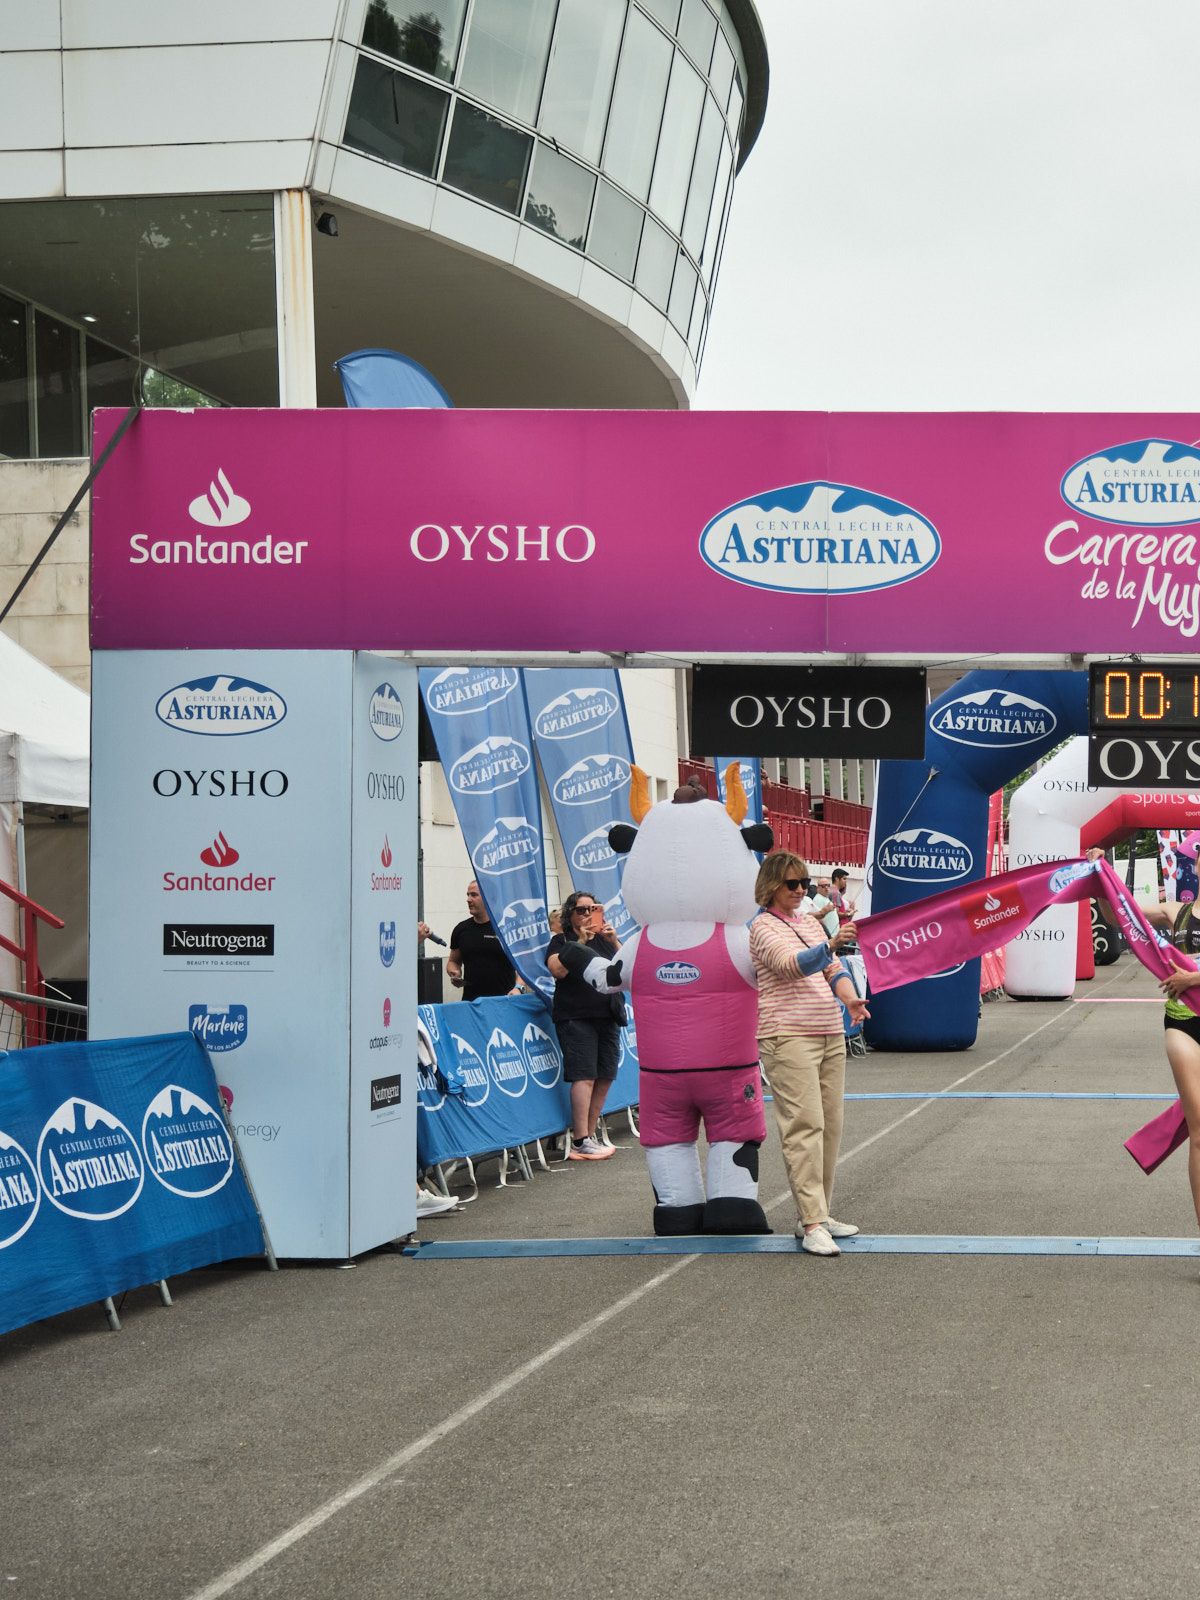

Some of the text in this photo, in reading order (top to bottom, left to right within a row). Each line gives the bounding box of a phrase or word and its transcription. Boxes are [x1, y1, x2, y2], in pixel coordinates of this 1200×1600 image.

[1103, 469, 1162, 479] CENTRAL
[755, 520, 915, 532] CENTRAL LECHERA
[129, 533, 308, 564] Santander
[409, 524, 597, 562] OYSHO
[718, 522, 923, 564] ASTURIANA
[1044, 520, 1197, 566] Carrera
[1081, 567, 1110, 600] de
[1115, 568, 1136, 600] la
[165, 697, 278, 721] ASTURIANA
[372, 702, 401, 728] ASTURIANA
[730, 695, 892, 730] OYSHO
[958, 707, 1045, 718] CENTRAL LECHERA
[937, 709, 1046, 734] ASTURIANA
[153, 769, 289, 797] OYSHO
[367, 772, 405, 802] OYSHO
[1132, 793, 1186, 807] Sports
[881, 847, 967, 871] ASTURIANA
[893, 845, 965, 856] CENTRAL LECHERA
[163, 872, 276, 892] Santander
[371, 872, 403, 891] Santander
[974, 904, 1020, 930] Santander
[171, 930, 267, 952] Neutrogena
[874, 921, 943, 960] OYSHO
[658, 970, 698, 979] ASTURIANA
[192, 1014, 245, 1040] Marlene
[372, 1084, 399, 1103] Neutrogena
[159, 1119, 218, 1137] CENTRAL LECHERA
[233, 1122, 281, 1142] nergy
[60, 1134, 127, 1155] CENTRAL LECHERA
[151, 1130, 229, 1174] ASTURIANA
[49, 1148, 140, 1197] ASTURIANA
